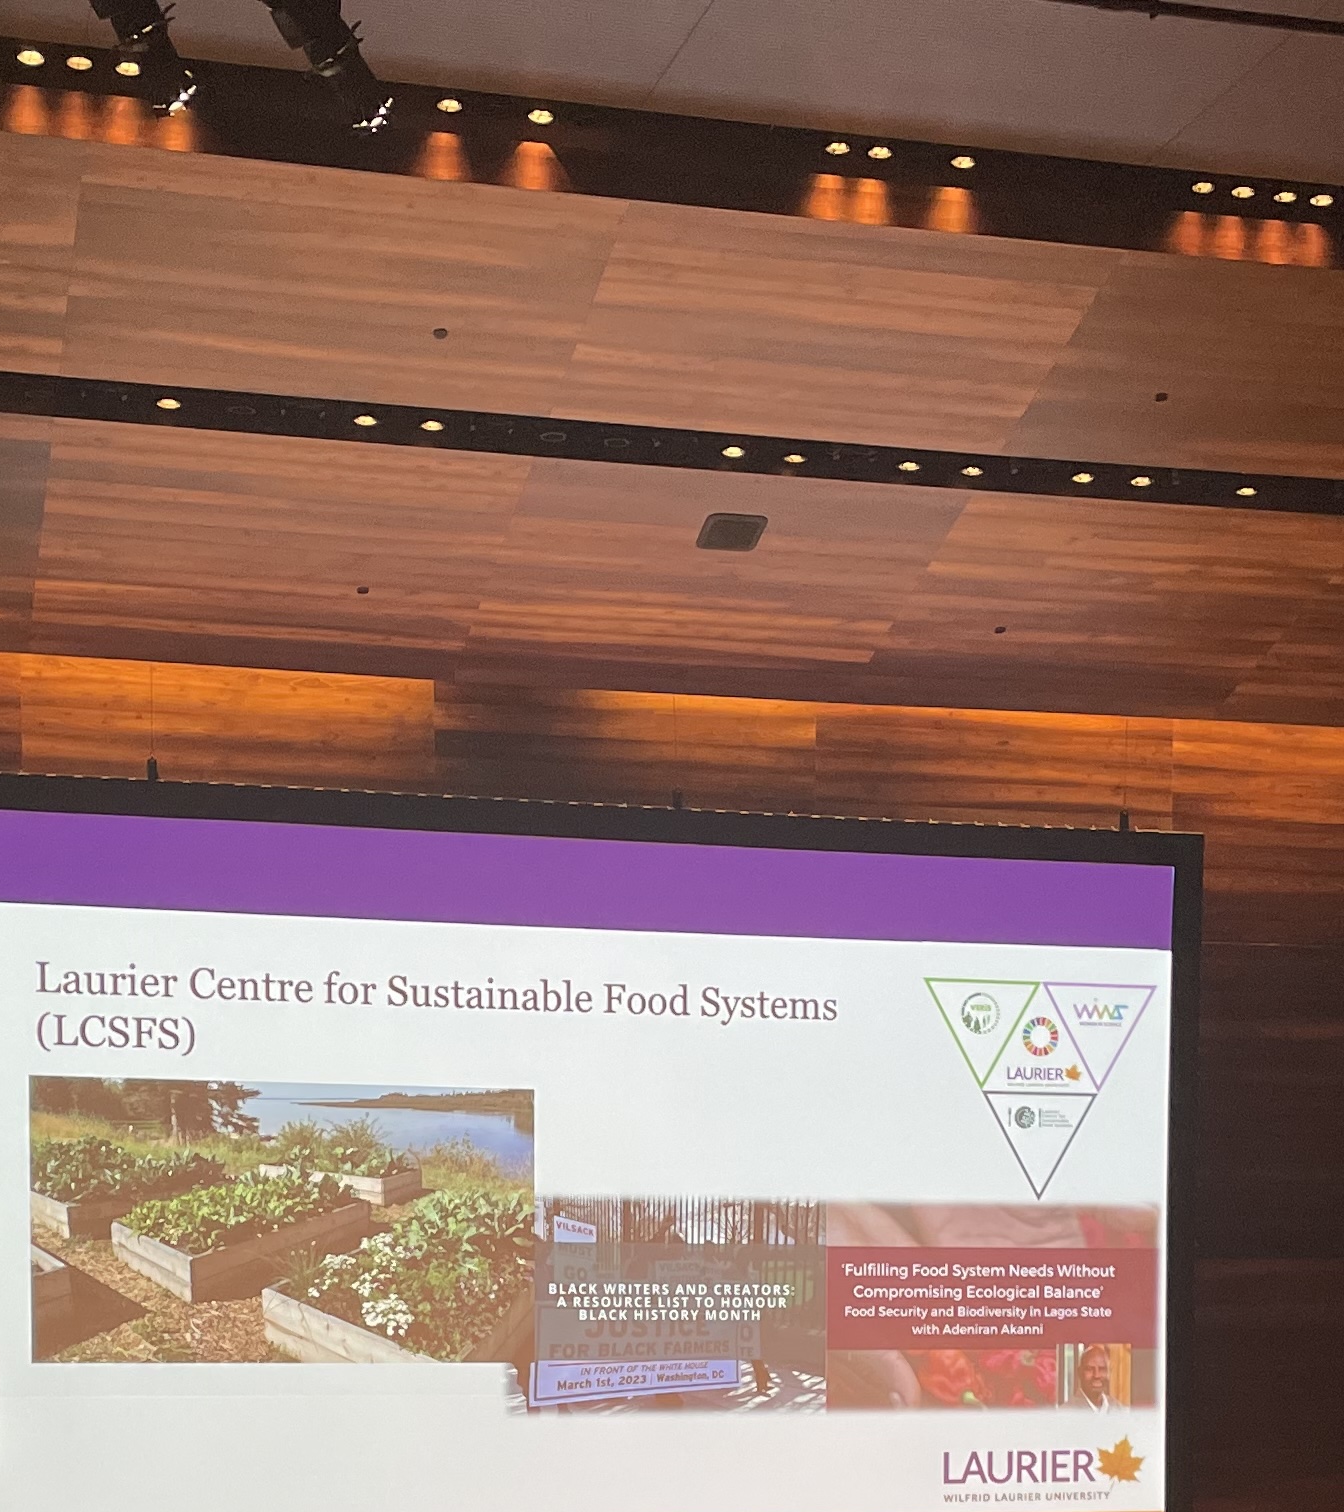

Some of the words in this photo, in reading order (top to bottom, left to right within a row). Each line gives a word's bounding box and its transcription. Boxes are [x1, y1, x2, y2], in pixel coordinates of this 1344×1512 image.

[35, 961, 178, 998] Laurier
[189, 967, 314, 1002] Centre
[324, 971, 377, 1007] for
[387, 975, 593, 1014] Sustainable
[603, 983, 691, 1017] Food
[701, 986, 838, 1027] Systems
[36, 1012, 197, 1057] (LCSFS)
[1006, 1066, 1065, 1081] LAURIER
[556, 1220, 595, 1238] VILSACK
[912, 1263, 949, 1277] Food
[952, 1264, 1006, 1281] System
[1009, 1264, 1054, 1278] Needs
[1056, 1264, 1116, 1278] Without
[548, 1282, 598, 1295] BLACK
[603, 1283, 670, 1296] WRITERS
[675, 1283, 709, 1296] AND
[713, 1284, 796, 1298] CREATORS:
[853, 1284, 963, 1301] Compromising
[966, 1285, 1040, 1302] Ecological
[556, 1296, 567, 1308] A
[573, 1296, 652, 1308] RESOURCE
[658, 1297, 689, 1308] LIST
[695, 1297, 715, 1308] TO
[721, 1297, 787, 1309] HONOUR
[579, 1309, 628, 1321] BLACK
[634, 1309, 699, 1321] HISTORY
[705, 1309, 761, 1321] MONTH
[844, 1305, 876, 1317] Food
[878, 1305, 929, 1320] Security
[930, 1305, 955, 1317] and
[957, 1305, 1028, 1320] Biodiversity
[1030, 1305, 1042, 1317] in
[1044, 1306, 1079, 1320] Lagos
[1080, 1306, 1112, 1318] State
[911, 1323, 940, 1335] with
[942, 1323, 999, 1336] Adeniran
[1000, 1323, 1044, 1336] Akanni
[549, 1343, 590, 1359] FOR
[598, 1342, 657, 1358] BLACK
[663, 1340, 730, 1355] FARMERS
[593, 1365, 625, 1375] FRONT
[627, 1364, 639, 1373] OF
[641, 1363, 657, 1372] THE
[659, 1362, 683, 1371] WHITE
[684, 1361, 709, 1370] HOUSE
[557, 1377, 592, 1391] March
[596, 1377, 615, 1388] 1st,
[618, 1374, 647, 1385] 2023
[656, 1371, 710, 1383] Washington,
[712, 1369, 725, 1379] DC
[943, 1450, 1096, 1485] LAURIER
[943, 1493, 991, 1503] WILFRID
[994, 1492, 1042, 1502] LAURIER
[1045, 1491, 1111, 1502] UNIVERSITY
